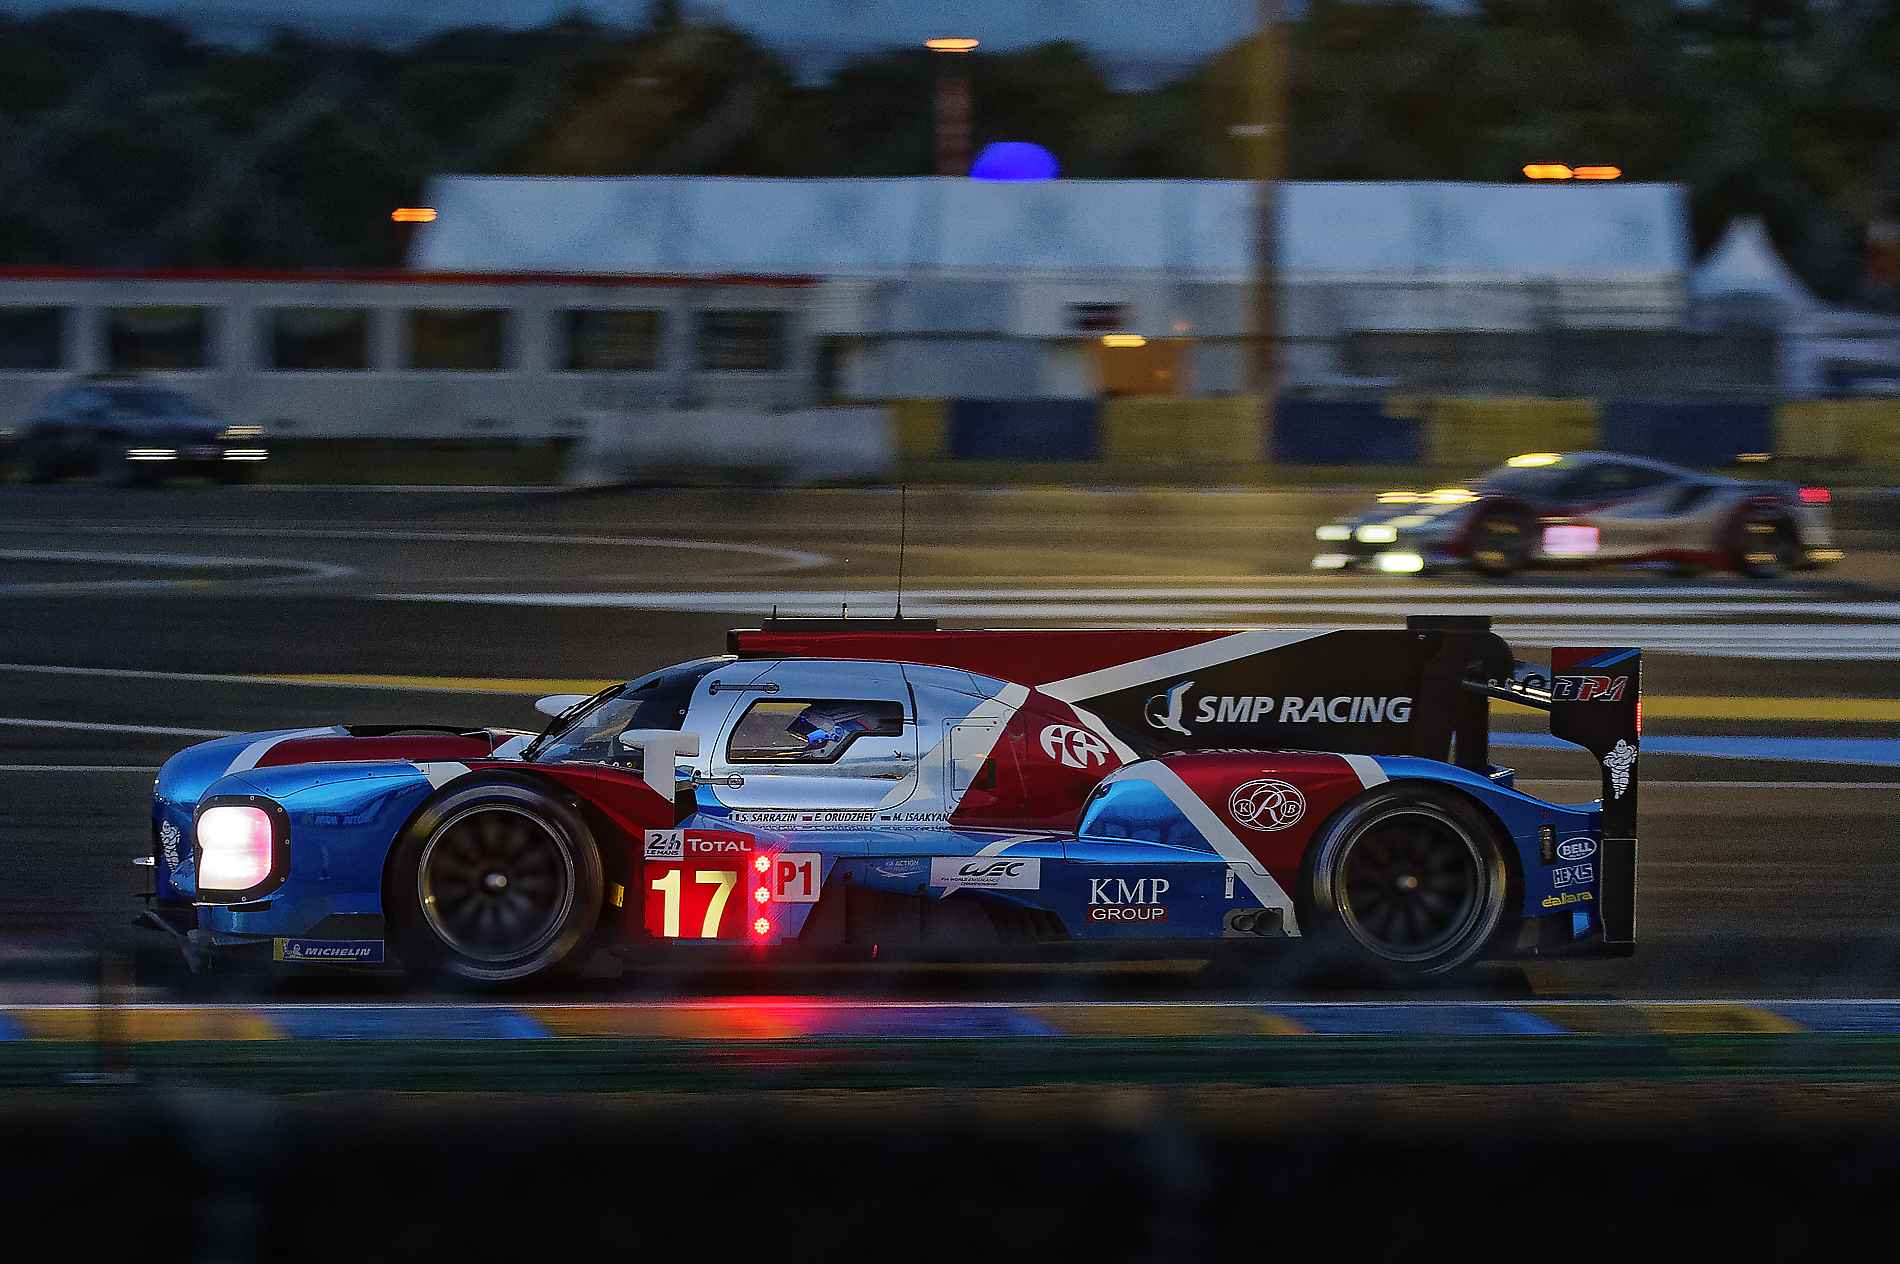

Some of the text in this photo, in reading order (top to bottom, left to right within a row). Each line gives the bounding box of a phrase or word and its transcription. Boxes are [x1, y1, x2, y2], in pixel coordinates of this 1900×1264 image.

[1195, 696, 1413, 723] SMP RACING
[751, 813, 798, 822] SARRAZIN
[825, 813, 877, 821] ORUDZHEV
[892, 812, 949, 821] M. ISAAKYAN
[687, 839, 752, 852] TOTAL
[1563, 842, 1593, 856] BELL
[959, 861, 1024, 877] WEC
[777, 861, 812, 896] P1
[1088, 878, 1170, 904] KMP
[652, 869, 737, 938] 17
[1092, 908, 1164, 920] GROUP
[305, 947, 371, 956] MICHELIN
